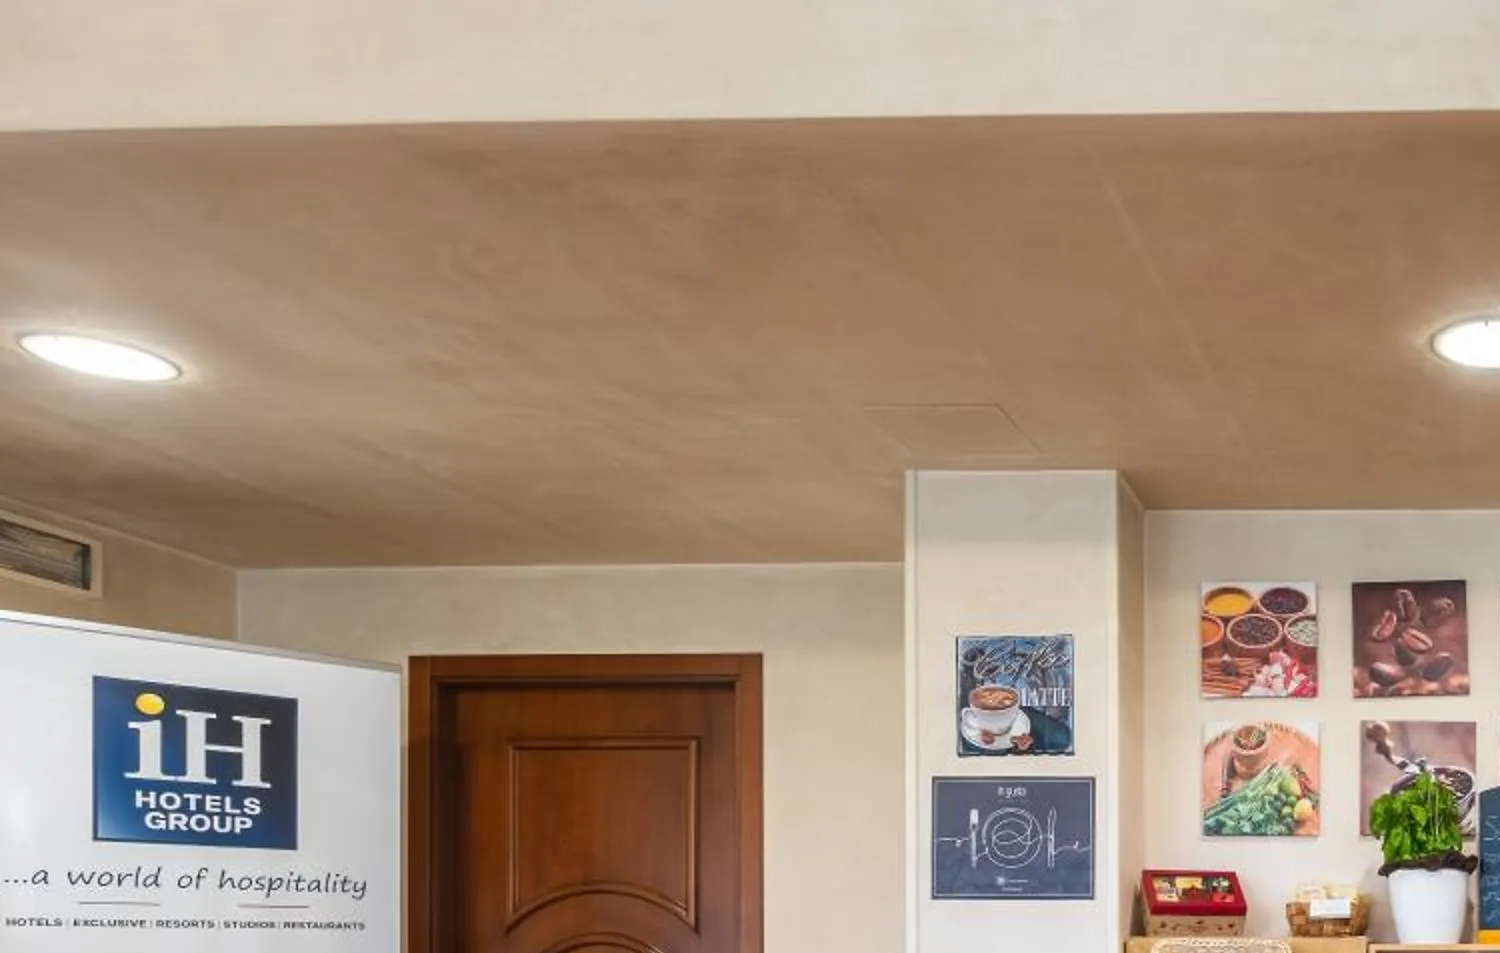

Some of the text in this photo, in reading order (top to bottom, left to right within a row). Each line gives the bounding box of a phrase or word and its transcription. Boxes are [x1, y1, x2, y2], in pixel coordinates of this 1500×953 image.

[124, 692, 272, 789] iH
[135, 789, 262, 816] HOTELS
[144, 810, 253, 834] GROUP
[67, 866, 161, 890] world
[177, 868, 209, 891] of
[218, 869, 367, 900] hospitality
[5, 917, 366, 931] HOTELS EXCLUSIVE RESORTS STUDIOS RESTAURANTS
